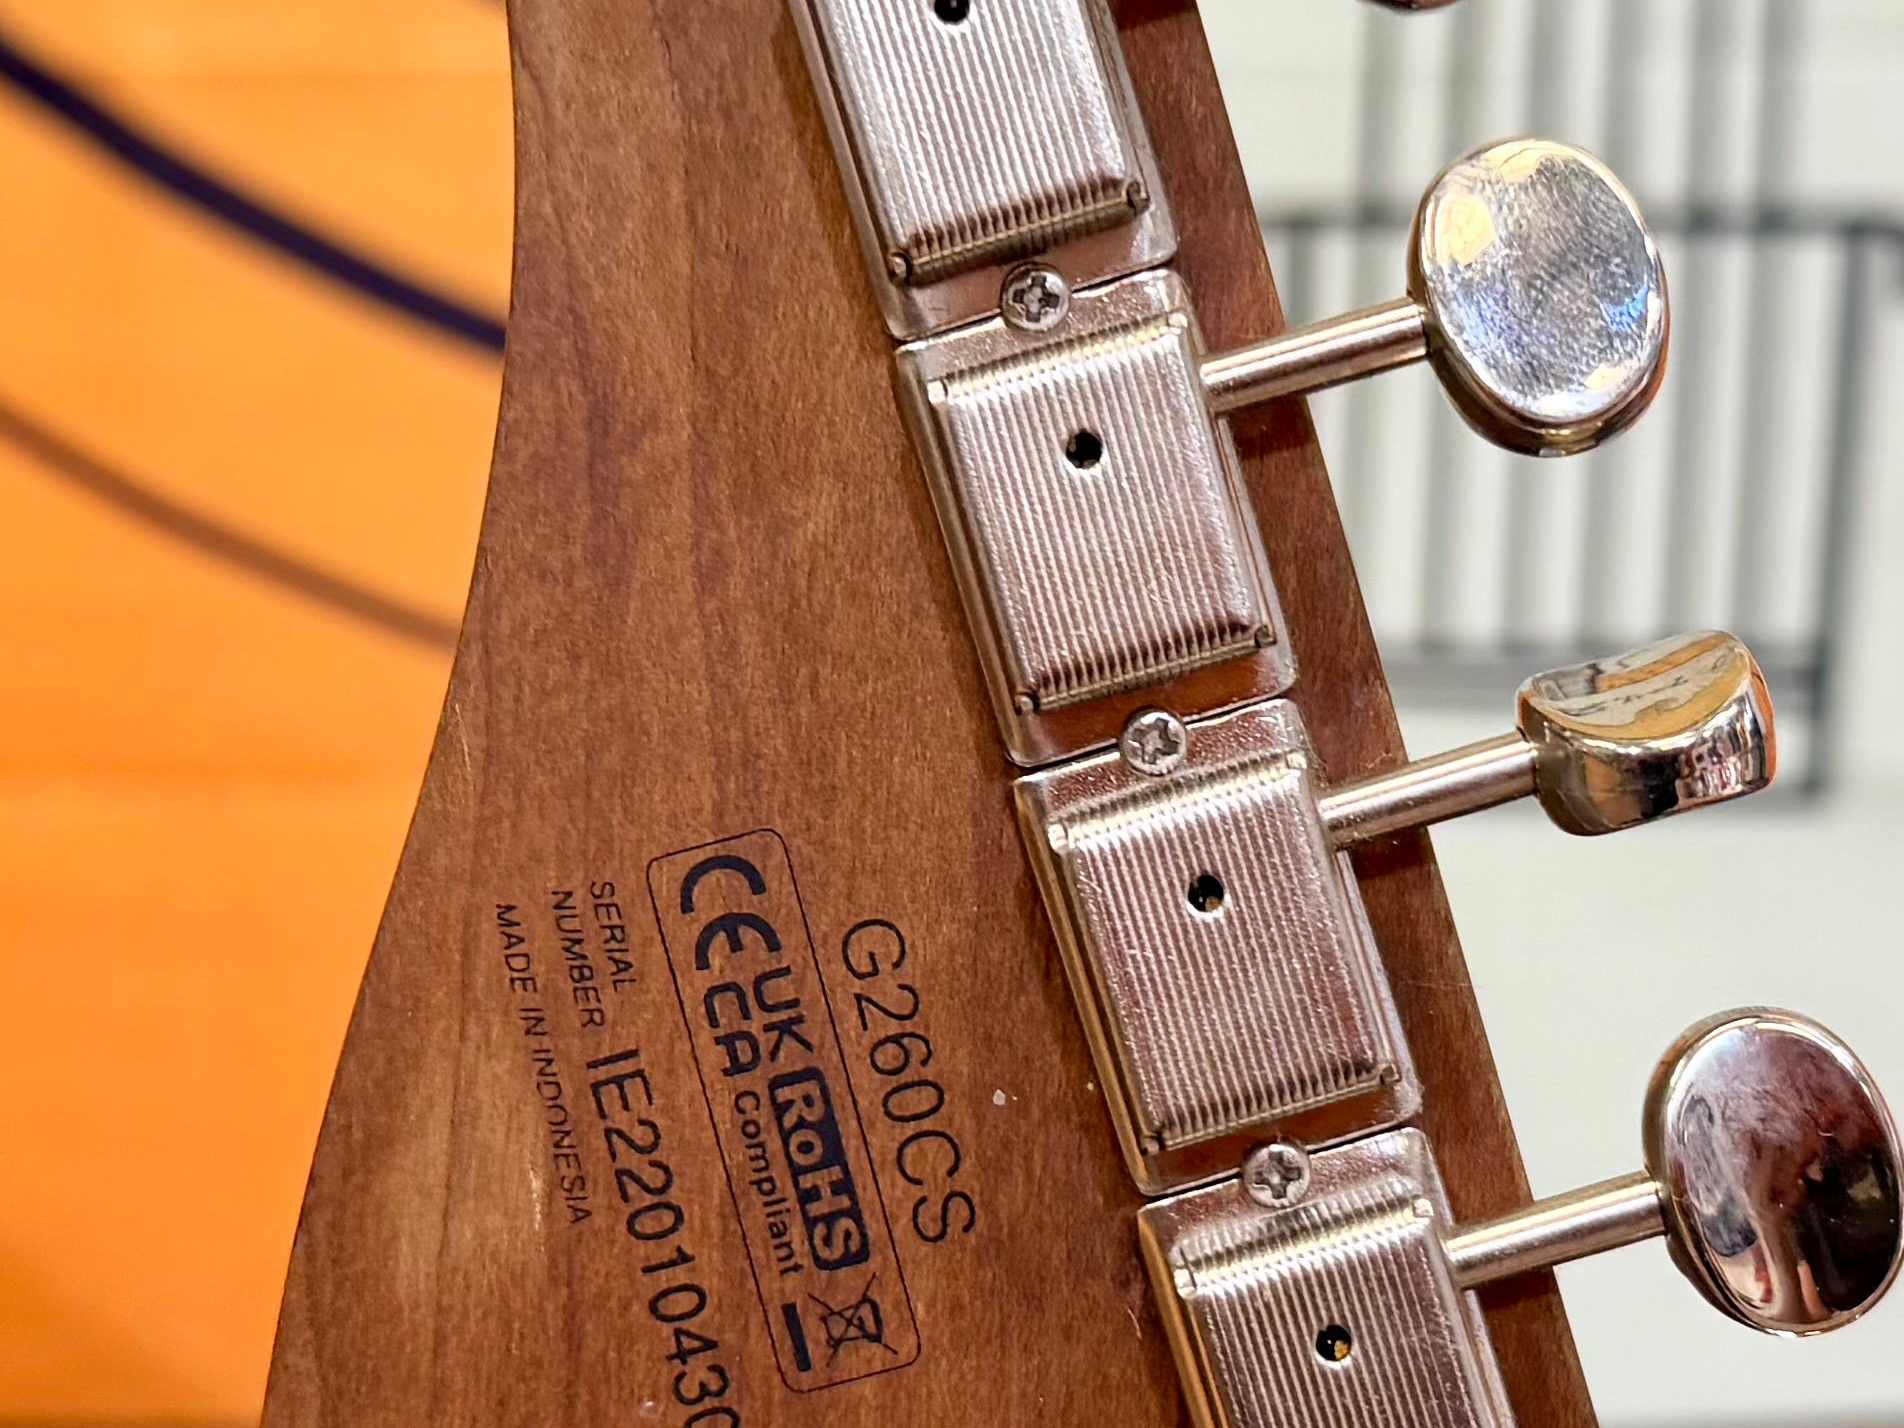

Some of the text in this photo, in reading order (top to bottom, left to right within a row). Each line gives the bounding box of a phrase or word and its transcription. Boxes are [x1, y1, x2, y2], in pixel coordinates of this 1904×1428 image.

[551, 891, 604, 1028] NUMBER
[590, 881, 637, 993] SERIAL
[753, 965, 814, 1062] UK
[496, 904, 592, 1224] MADE IN INDONESIA
[842, 918, 976, 1244] G260CS
[734, 1090, 804, 1275] compliant
[773, 1079, 863, 1263] RoHS
